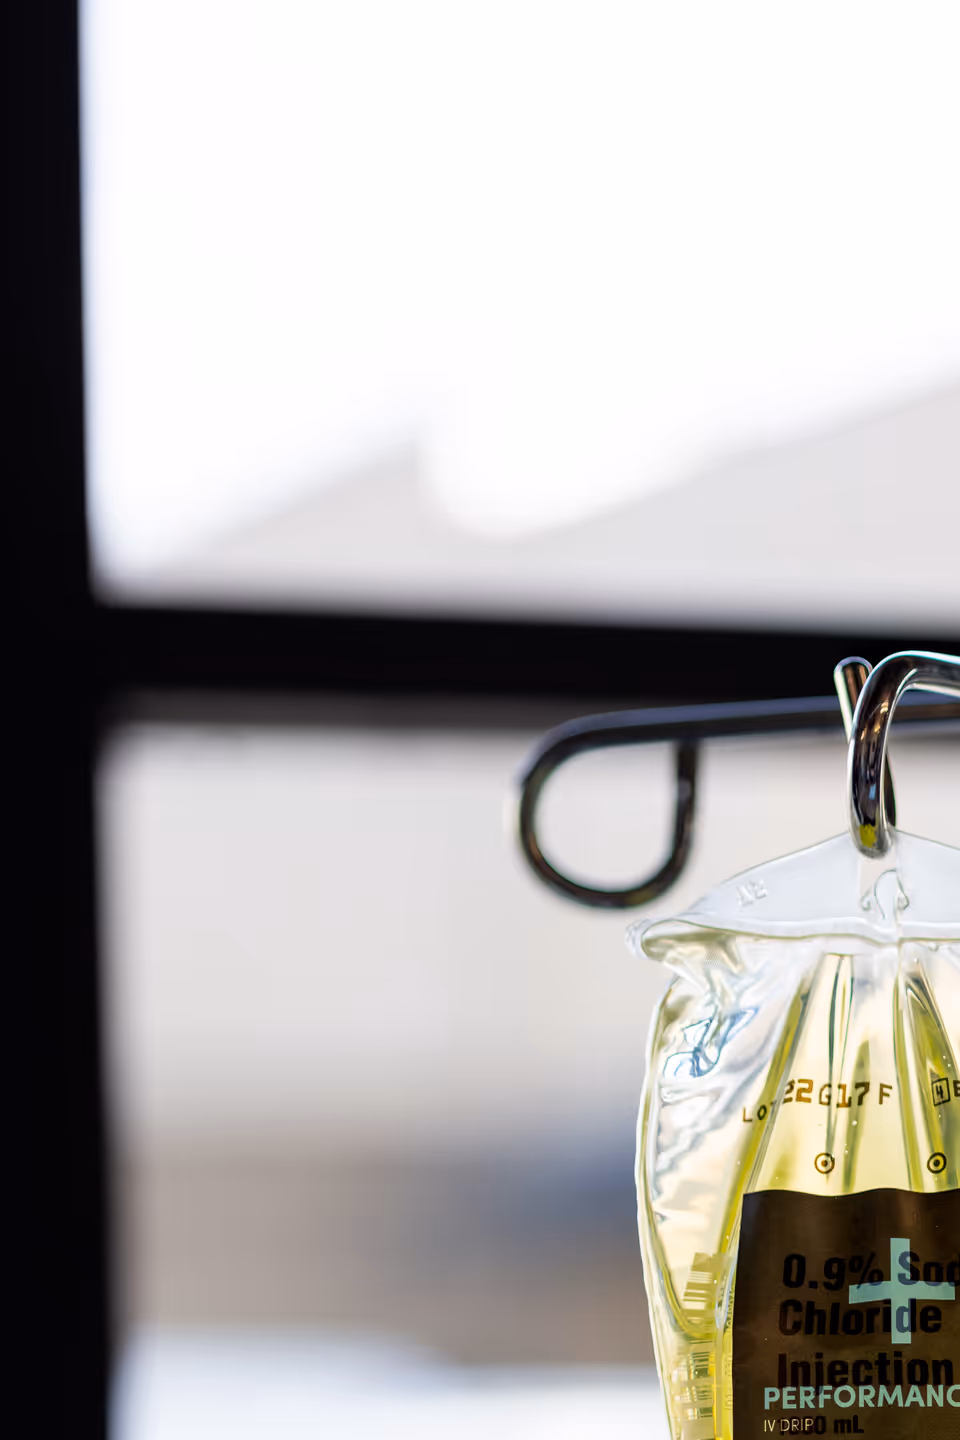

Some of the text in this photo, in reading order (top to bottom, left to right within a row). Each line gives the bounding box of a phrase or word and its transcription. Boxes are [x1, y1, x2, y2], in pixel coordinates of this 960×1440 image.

[782, 1252, 884, 1291] 0.9%
[777, 1297, 943, 1336] Chloride
[777, 1350, 954, 1396] Injection
[763, 1417, 815, 1433] IV DRIP
[833, 1414, 865, 1436] mL
